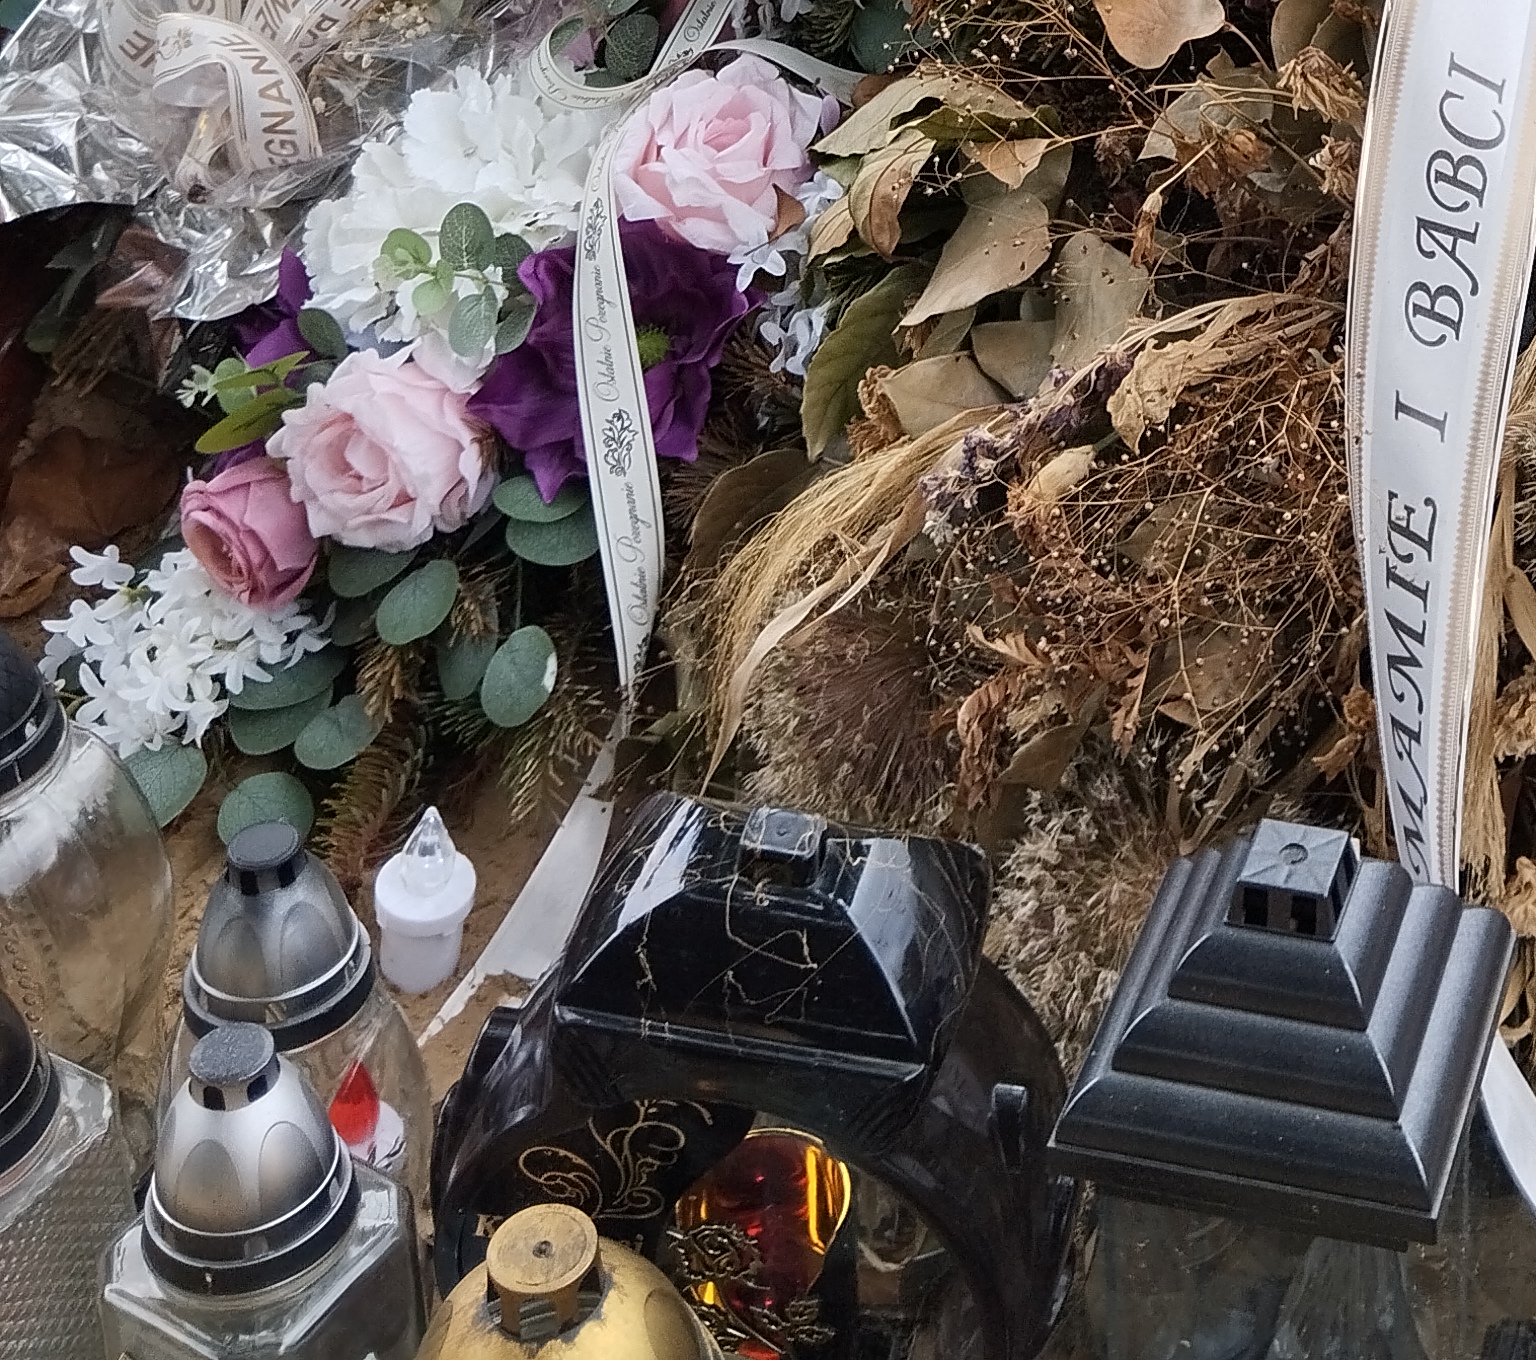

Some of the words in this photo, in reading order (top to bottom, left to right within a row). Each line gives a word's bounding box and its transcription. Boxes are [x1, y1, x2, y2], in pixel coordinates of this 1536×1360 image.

[1405, 51, 1507, 350] BABCI
[1394, 388, 1448, 444] I
[1383, 489, 1438, 883] MAMIE
